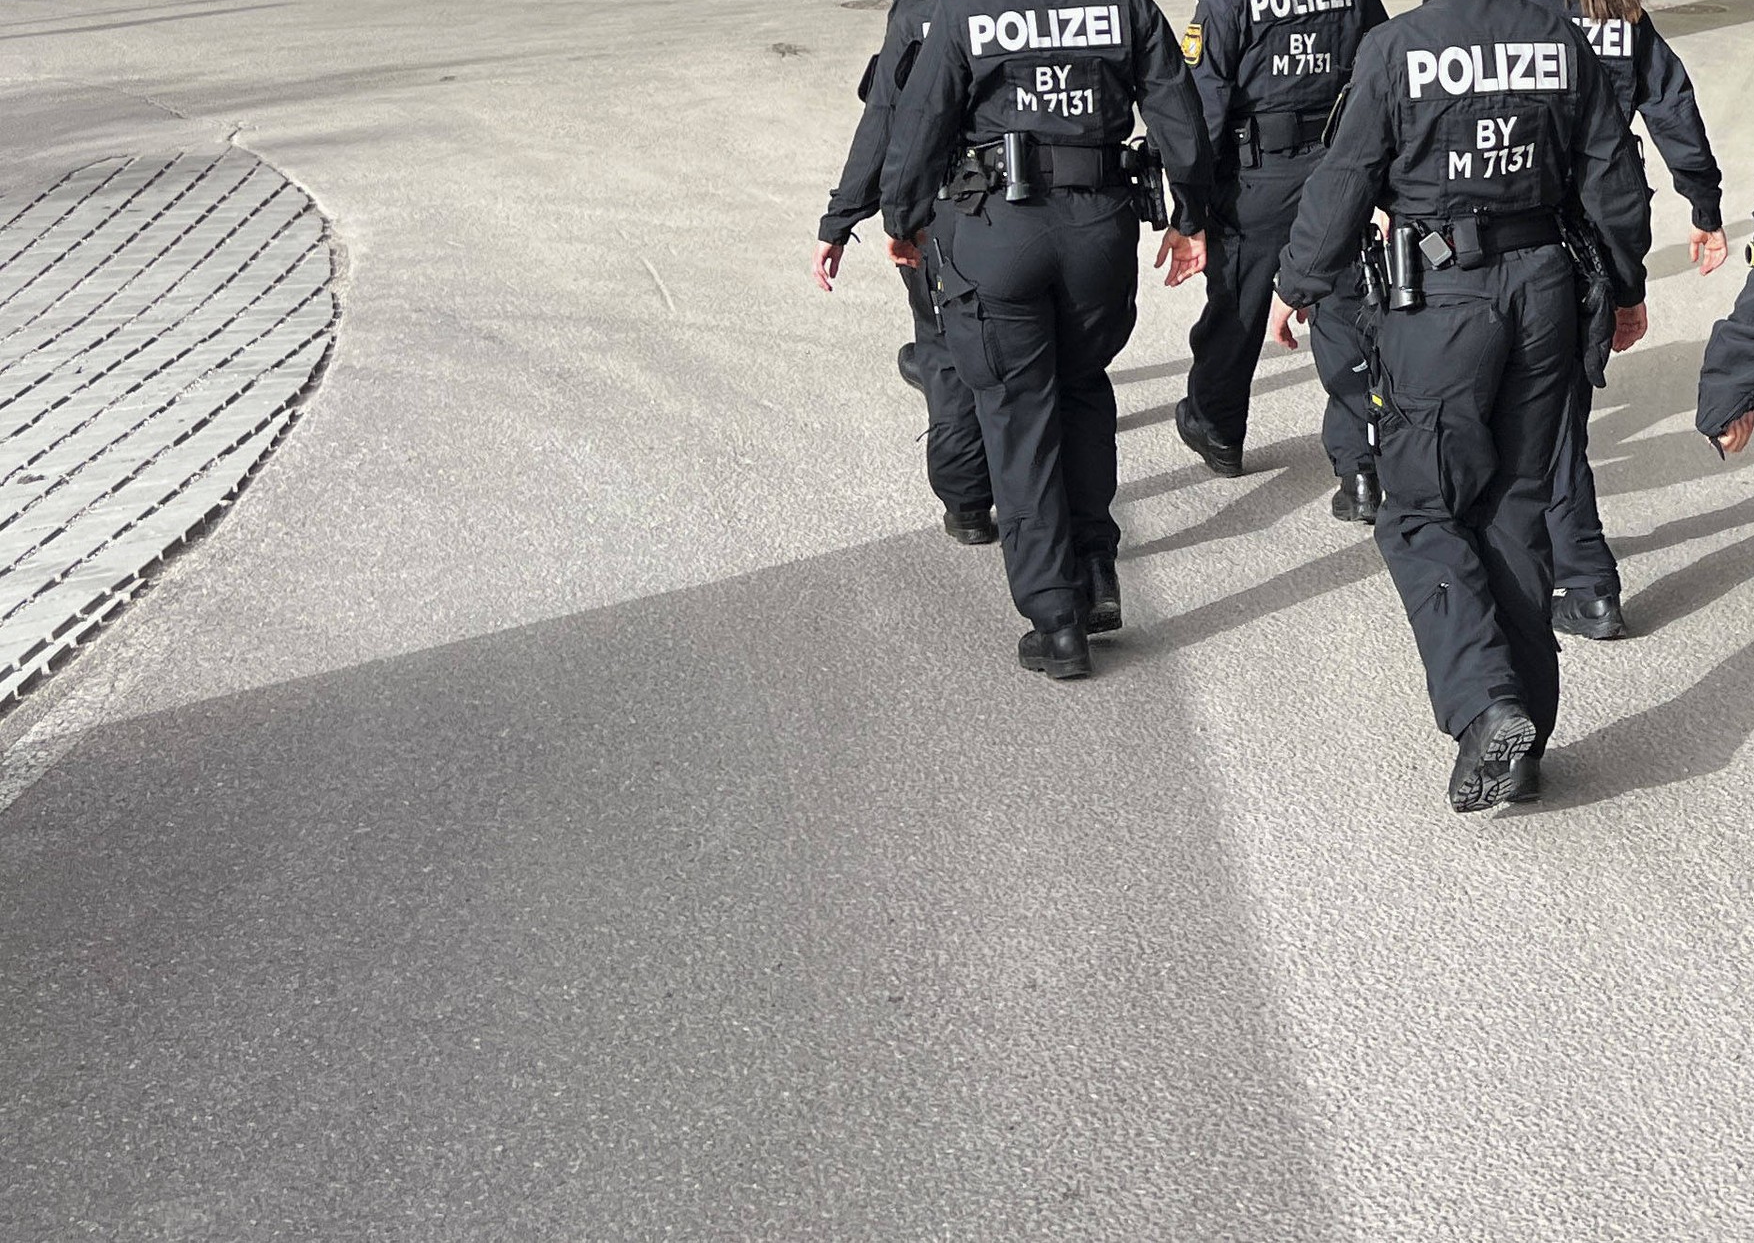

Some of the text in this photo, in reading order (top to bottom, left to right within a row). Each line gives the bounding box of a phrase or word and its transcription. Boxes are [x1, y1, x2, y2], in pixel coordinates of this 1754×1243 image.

[968, 4, 1122, 57] POLIZEI
[1289, 32, 1317, 55] BY
[1035, 64, 1072, 93] BY
[1272, 52, 1331, 77] M 7131
[1406, 41, 1568, 99] POLIZEI
[1016, 87, 1094, 117] M 7131
[1476, 116, 1518, 149] BY
[1448, 142, 1535, 181] M 7131
